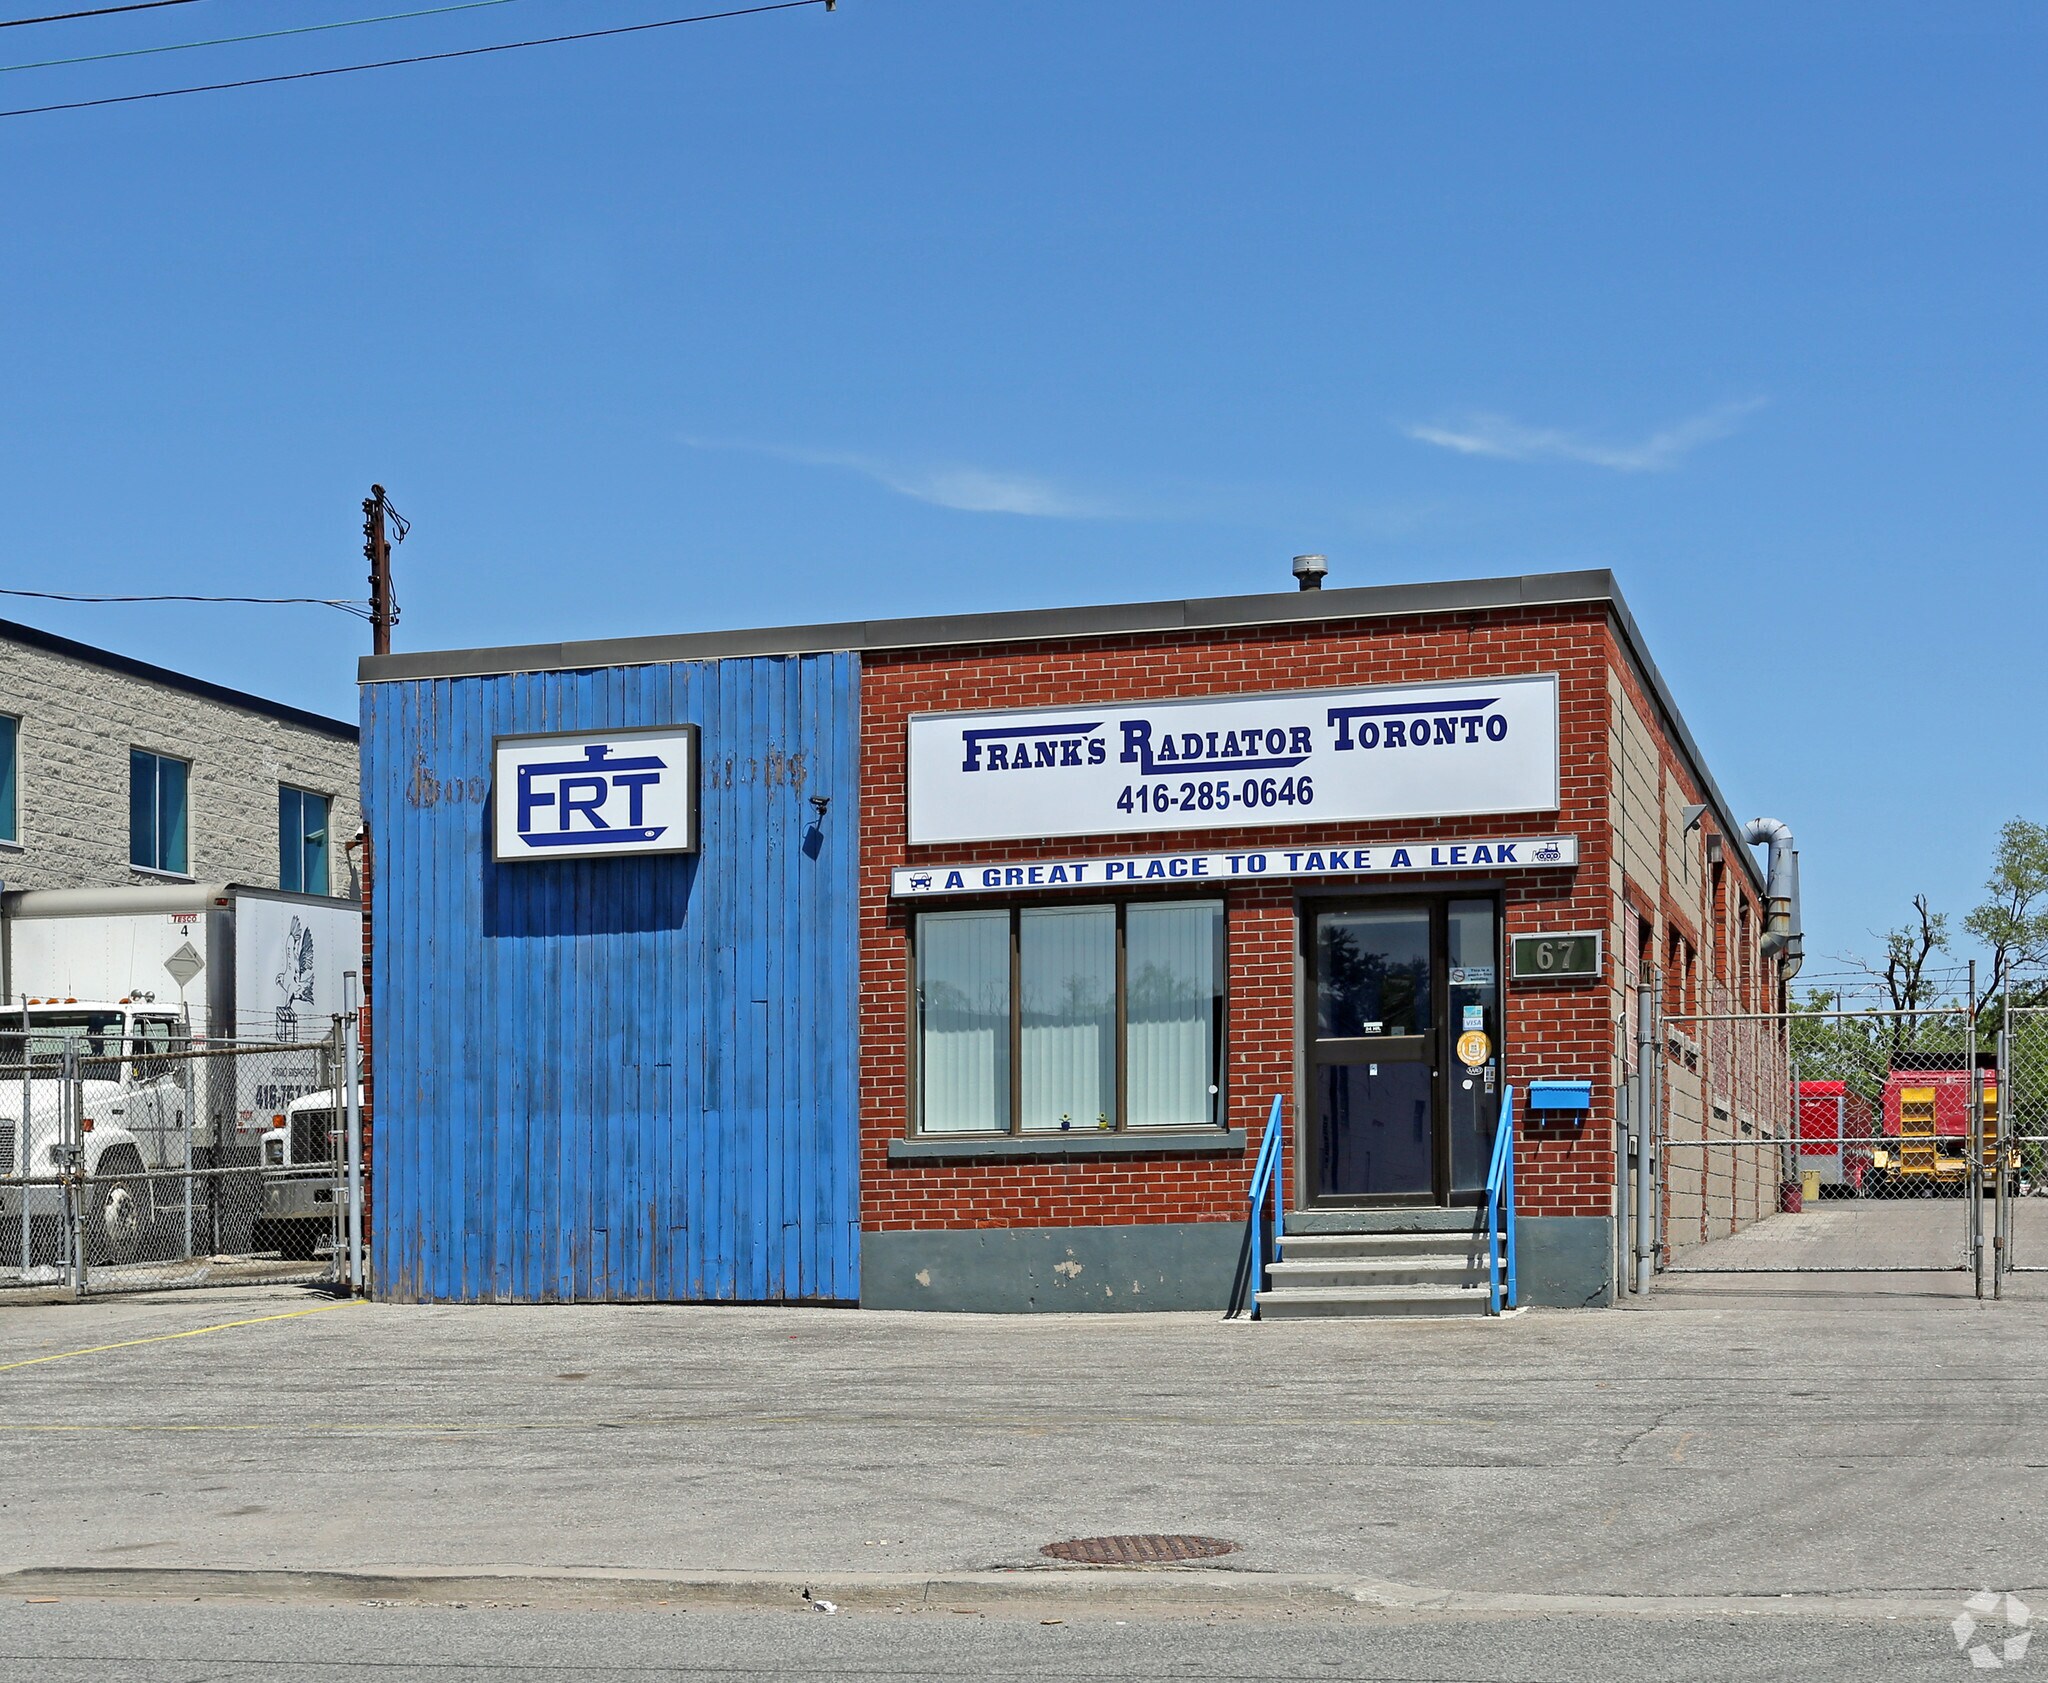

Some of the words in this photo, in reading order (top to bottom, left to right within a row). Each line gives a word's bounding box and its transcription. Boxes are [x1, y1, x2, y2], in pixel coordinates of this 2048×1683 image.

[962, 722, 1106, 772] FRANK'S
[1120, 720, 1312, 775] RADIATOR
[1328, 698, 1508, 751] TORONTO
[516, 756, 668, 833] FRT
[1117, 776, 1314, 814] 416-285-0646
[945, 871, 964, 889] A
[983, 864, 1088, 887] GREAT
[1106, 857, 1208, 881] PLACE
[1231, 854, 1267, 873] TO
[1284, 851, 1371, 872] TAKE
[1391, 849, 1411, 868] A
[1431, 844, 1518, 866] LEAK
[171, 913, 198, 923] TESCO
[180, 924, 189, 937] 4
[1536, 941, 1575, 970] 67
